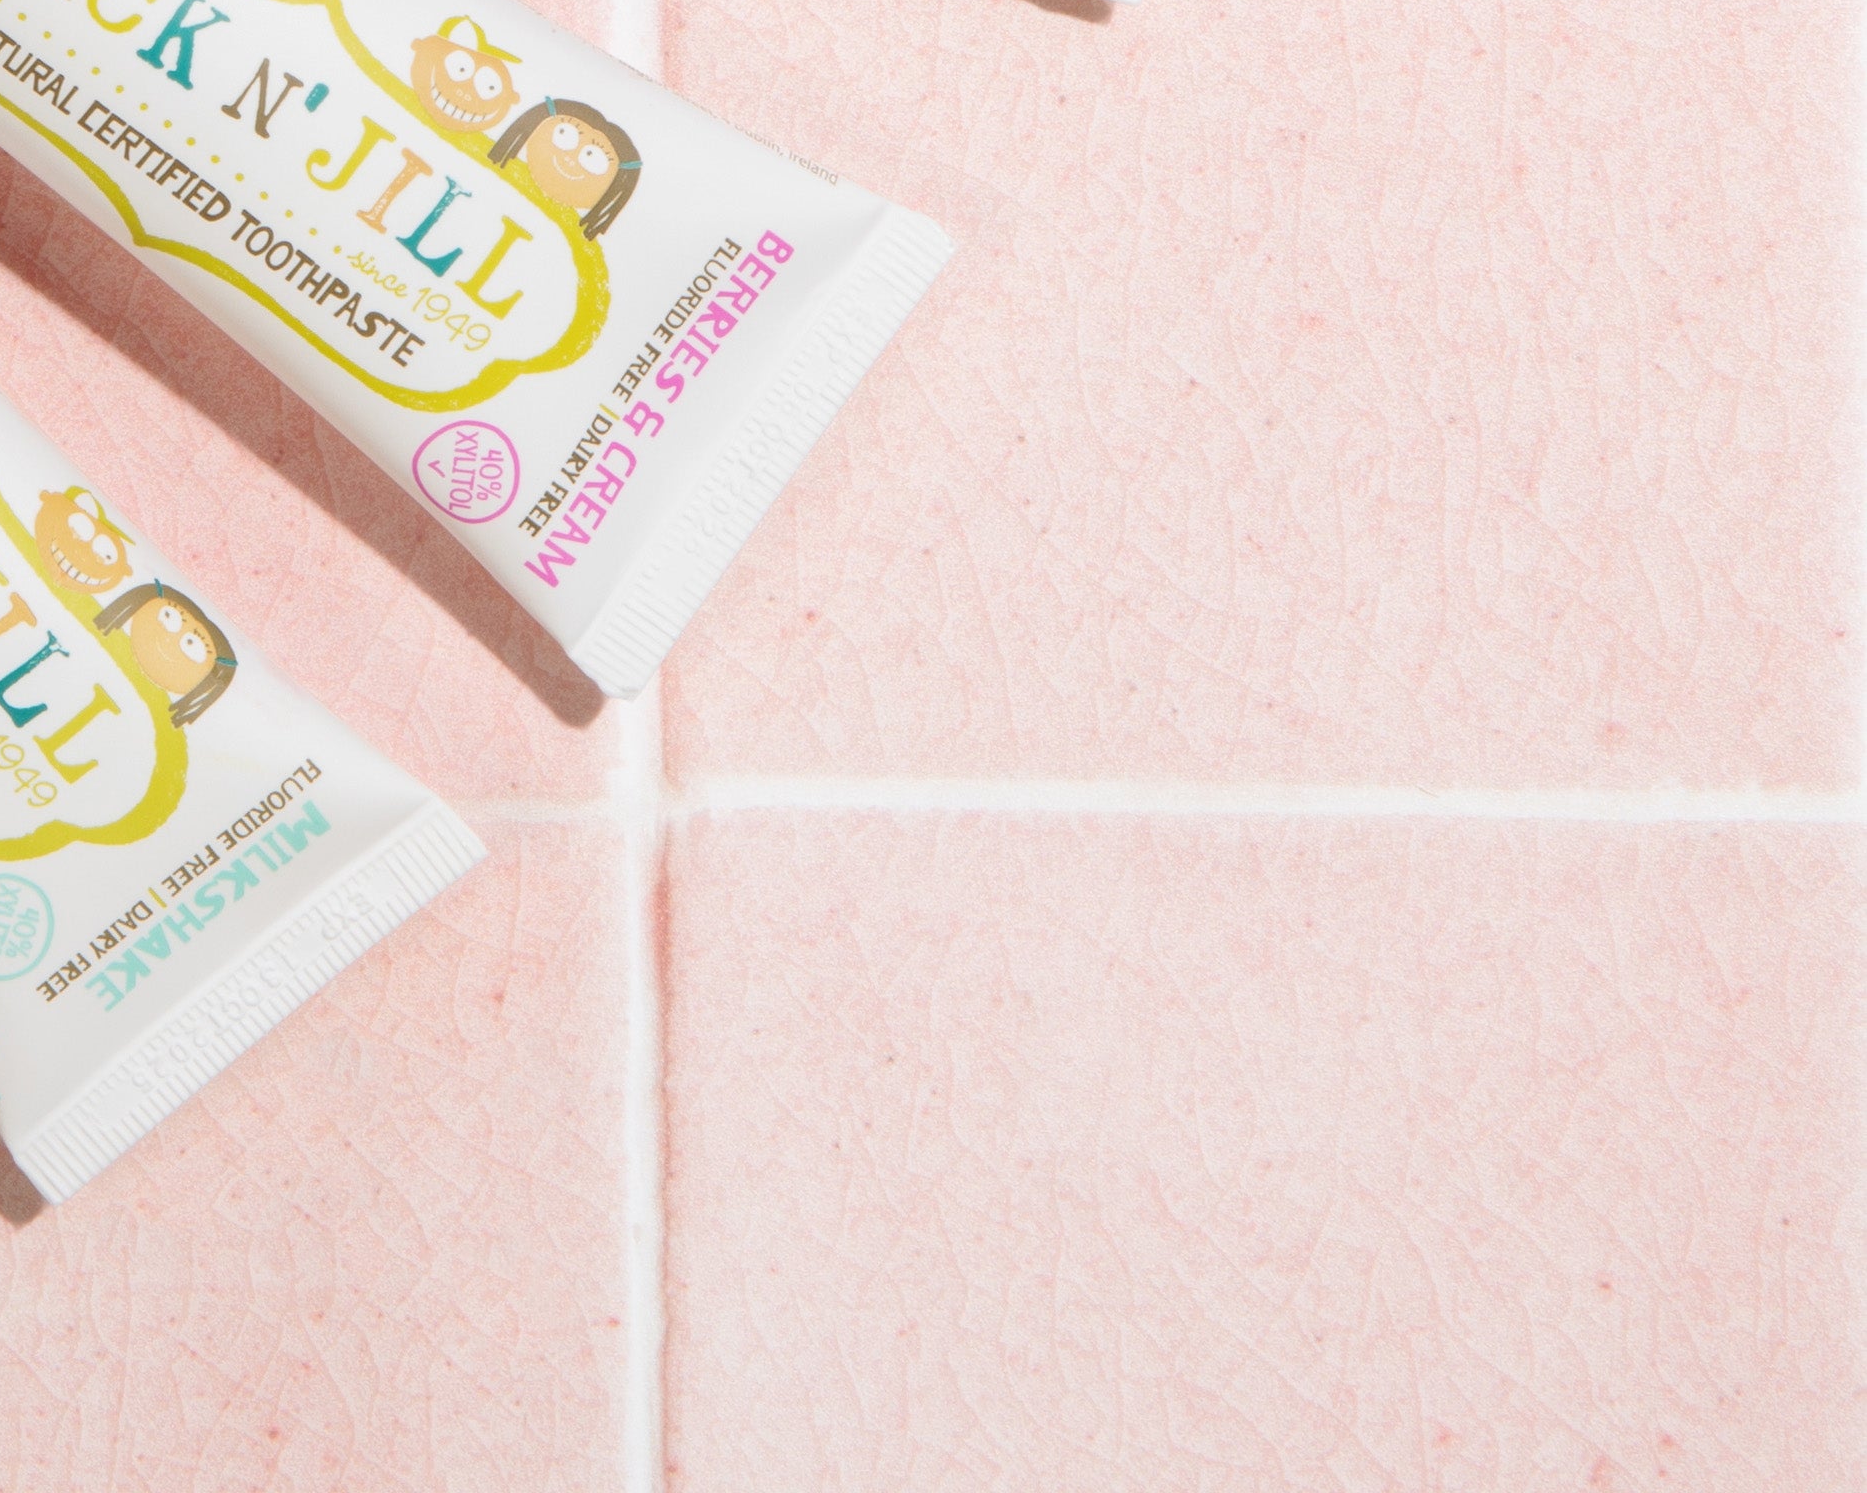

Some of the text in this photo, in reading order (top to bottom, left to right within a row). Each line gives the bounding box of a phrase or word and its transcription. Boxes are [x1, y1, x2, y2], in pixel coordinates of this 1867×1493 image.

[75, 100, 231, 222] CERTIFIED
[231, 209, 439, 367] TOOTHPASTE
[221, 58, 329, 139] N'
[305, 125, 534, 321] JILL
[346, 251, 492, 353] since 1949
[655, 230, 794, 403] BERRIES
[518, 238, 742, 537] FLUORIDE FREE DAIRY FREE
[622, 401, 665, 437] &
[448, 431, 478, 512] XYLITOL
[478, 449, 503, 501] 40%
[524, 441, 637, 588] CREAM
[8, 907, 40, 958] 40%
[36, 759, 321, 1002] FLUORIDE FREE DAIRY FREE
[85, 800, 331, 1012] MILKSHAKE
